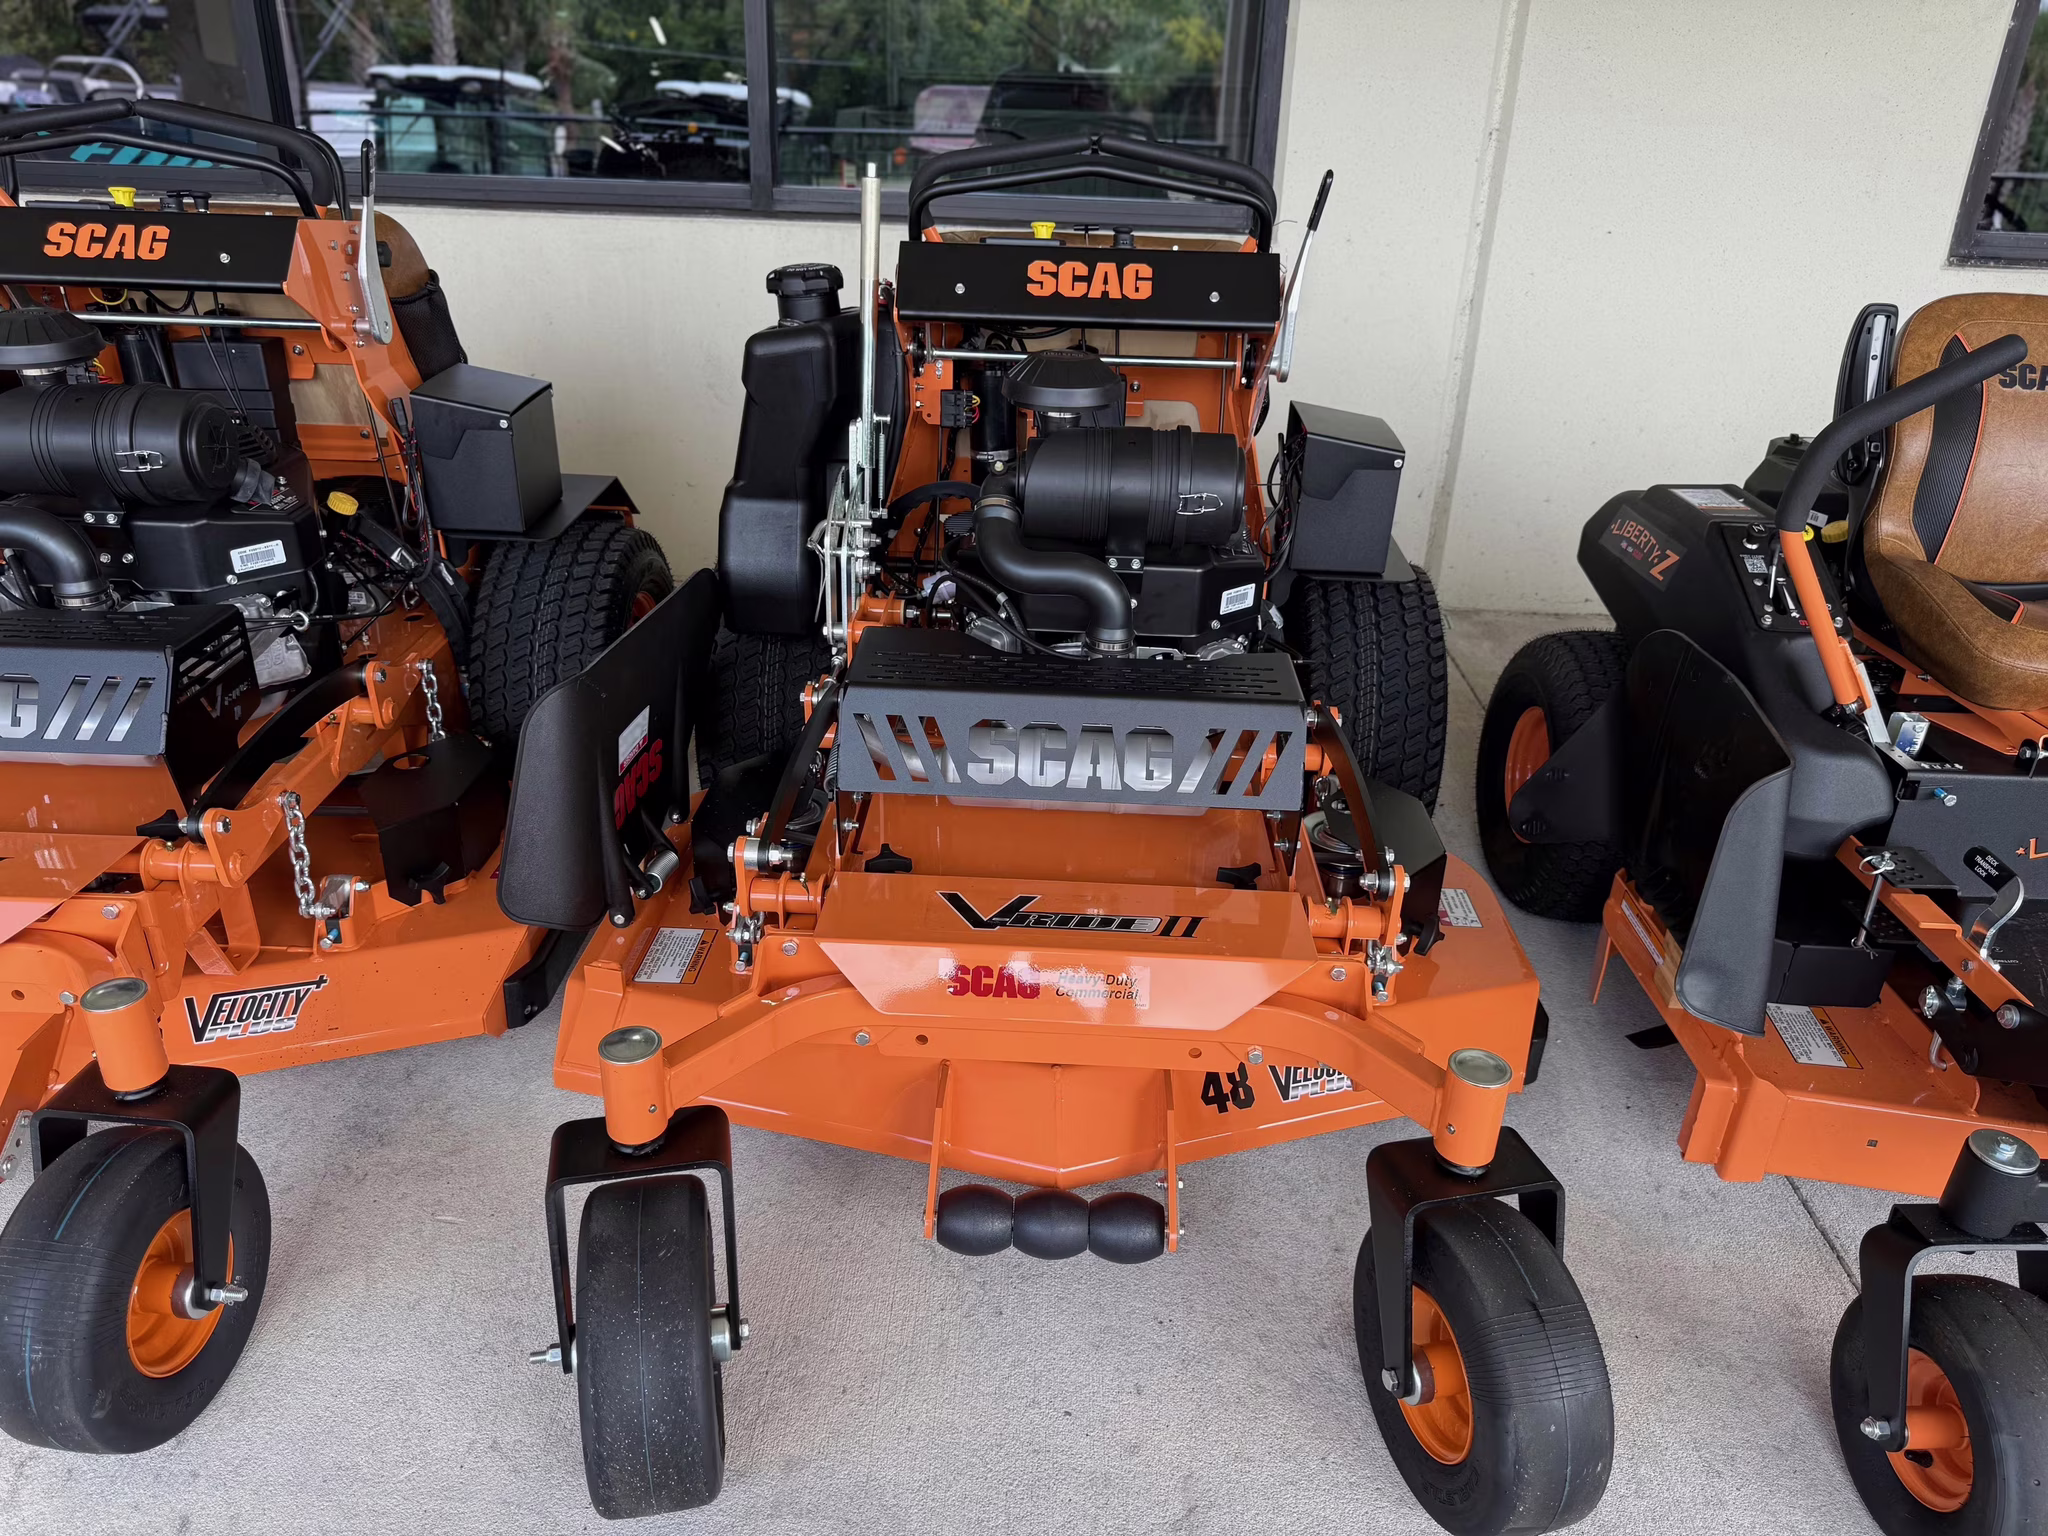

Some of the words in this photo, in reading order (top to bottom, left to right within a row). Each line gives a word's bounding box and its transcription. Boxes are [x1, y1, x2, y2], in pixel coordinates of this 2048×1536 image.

[43, 222, 170, 261] SCAG
[1026, 260, 1153, 300] SCAG
[1612, 519, 1661, 562] LIBERTY
[1649, 549, 1680, 581] Z
[967, 719, 1174, 792] SCAG
[1974, 855, 1999, 877] TRANSPORT
[1974, 865, 1988, 878] LOCK
[1985, 855, 1999, 867] DECK
[949, 965, 1040, 999] SCAG
[1055, 985, 1140, 1000] Commercial
[1057, 971, 1137, 988] Heavy-Duty
[205, 1016, 297, 1042] PLUS
[1823, 1025, 1850, 1054] WARNING
[1201, 1062, 1255, 1114] 48
[1268, 1064, 1345, 1102] VELOC
